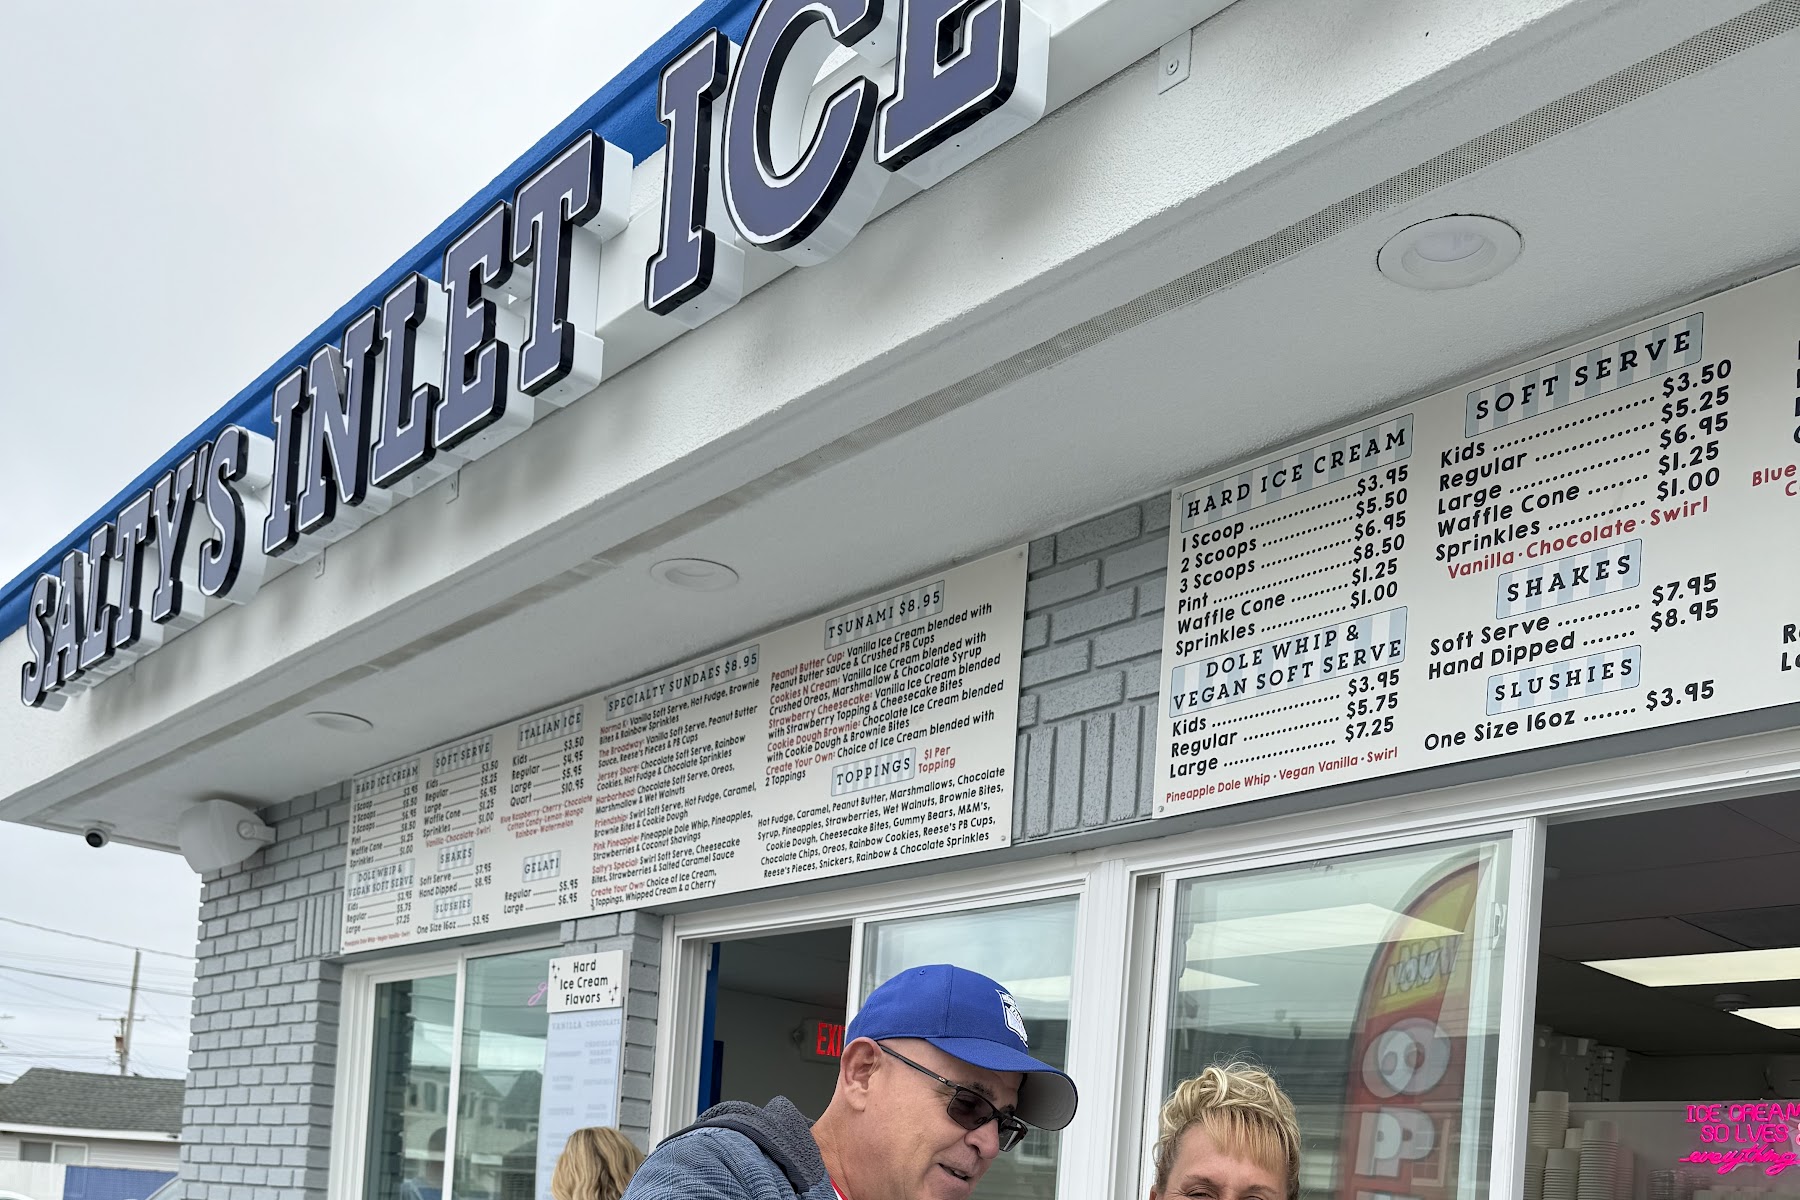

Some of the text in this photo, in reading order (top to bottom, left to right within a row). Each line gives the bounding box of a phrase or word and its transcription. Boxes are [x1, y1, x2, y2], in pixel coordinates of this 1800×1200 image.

[20, 0, 1022, 708] SALTY'S INLET ICE
[1475, 329, 1691, 420] SOFT SERVE
[1438, 383, 1729, 492] Regular $5.25
[1439, 358, 1732, 469] Kids $3.50
[1186, 427, 1406, 519] HARD ICE CREAM
[1436, 439, 1719, 538] Waffle Cone $1.25
[1437, 410, 1729, 516] Large $6.95
[1751, 463, 1797, 487] Blue
[1179, 486, 1408, 574] 2 Scoops $5.50
[1181, 463, 1409, 553] 1 Scoop $3.95
[1434, 466, 1720, 563] Sprinkles $1.00
[1178, 509, 1406, 594] 3 Scoops $6.95
[1446, 494, 1708, 580] Vanilla Chocolate Swirl
[1176, 556, 1398, 635] Waffle Cone $1.25
[1177, 532, 1405, 615] Pint $8.50
[1506, 553, 1630, 602] SHAKES
[770, 601, 993, 682] Peanut Butter Cup: Vanilla Ice Cream blended with
[827, 589, 940, 639] TSUNAMI $8.95
[1174, 580, 1398, 658] Sprinkles $1.00
[1428, 597, 1719, 681] Hand Dipped $8.95
[1429, 571, 1717, 657] Soft Serve $7.95
[769, 633, 935, 693] Peanut Butter sauce & Crushed PB Cups
[1172, 638, 1401, 710] VEGAN SOFT SERVE
[1205, 623, 1359, 679] DOLE WHIP &
[608, 652, 757, 712] SPECIALTY SUNDAES $8.95
[1171, 667, 1400, 738] Kids $3.95
[1494, 657, 1632, 702] SLUSHIES
[519, 711, 582, 742] ITALIAN ICE
[1170, 690, 1398, 758] Regular $5.75
[1423, 678, 1714, 751] One Size 16oz $3.95
[434, 741, 490, 769] SOFT SERVE
[511, 735, 585, 767] Kids $3.50
[511, 749, 584, 781] Regular $4.95
[835, 756, 910, 786] TOPPINGS
[917, 756, 956, 774] Topping
[923, 745, 951, 761] $1 Per
[1165, 745, 1398, 804] Pineapple Dole Whip Vegan Vanilla Swirl
[1169, 714, 1394, 779] Large $7.25
[355, 764, 419, 795] HARD ICE CREAM
[509, 777, 584, 807] Quart $10.95
[510, 763, 583, 794] Large $5.95
[439, 847, 472, 864] SHAKES
[523, 857, 559, 874] GELATI
[763, 831, 990, 879] Reese's Pieces, Snickers, Rainbow & Chocolate Sprinkles
[435, 898, 471, 914] SLUSHIES
[503, 891, 578, 915] Large $6.95
[504, 877, 579, 902] Regular $5.95
[416, 913, 490, 935] One Size 16oz $3.95
[560, 976, 608, 990] Ice Cream
[573, 959, 596, 973] Hard
[565, 993, 601, 1005] Flavors
[816, 1022, 846, 1057] EXI
[1686, 1103, 1721, 1122] ICE
